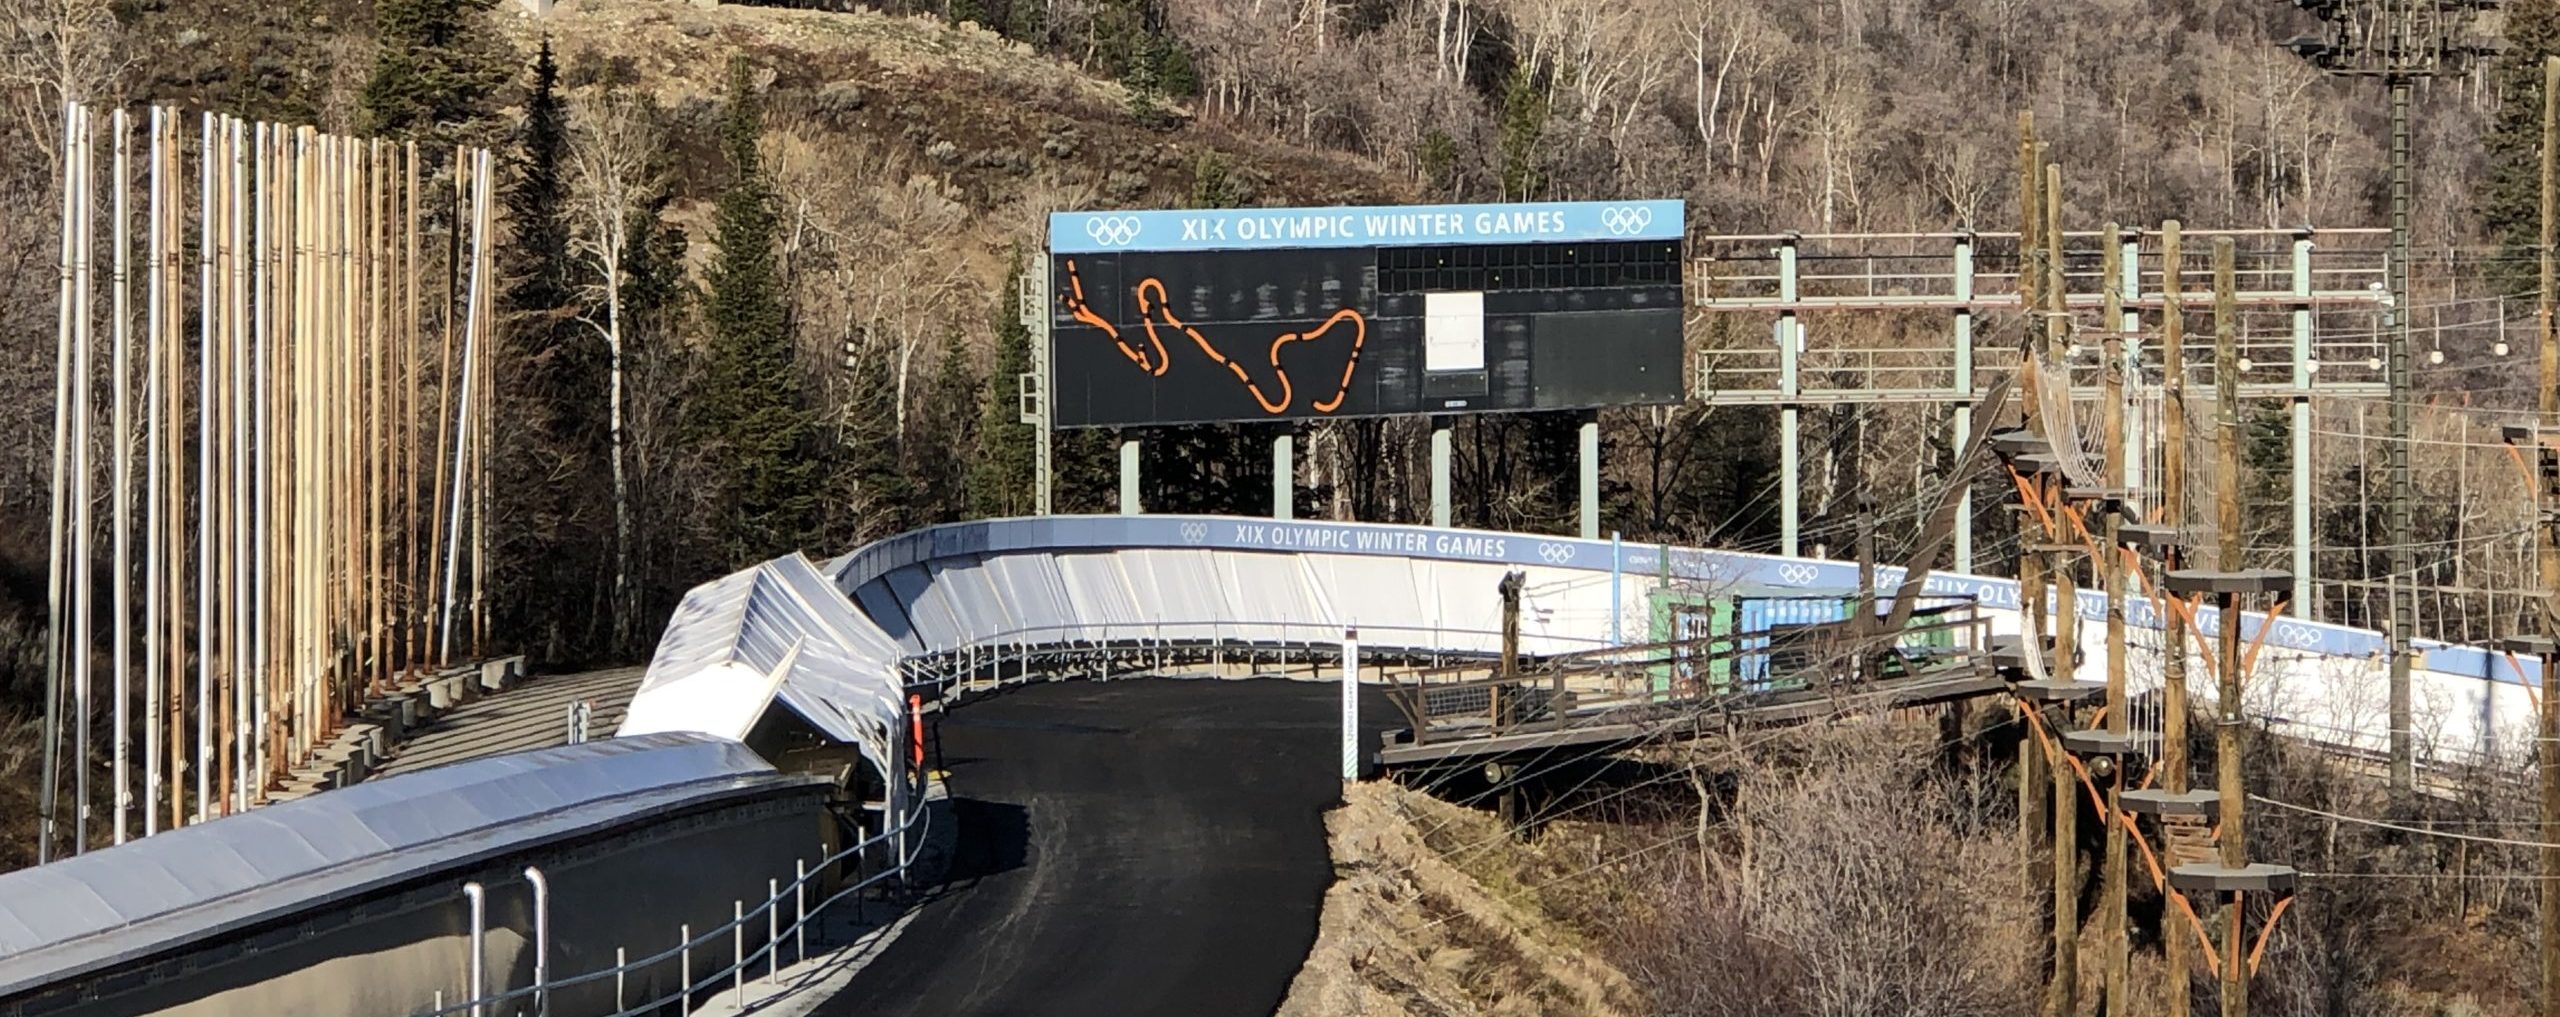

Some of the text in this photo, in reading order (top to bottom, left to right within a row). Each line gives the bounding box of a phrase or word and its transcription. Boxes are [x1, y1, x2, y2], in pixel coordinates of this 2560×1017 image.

[1181, 211, 1565, 241] XIX OLYMPIC WINTER GAMES
[1235, 523, 1506, 558] XIX OLYMPIC WINTER GAMES
